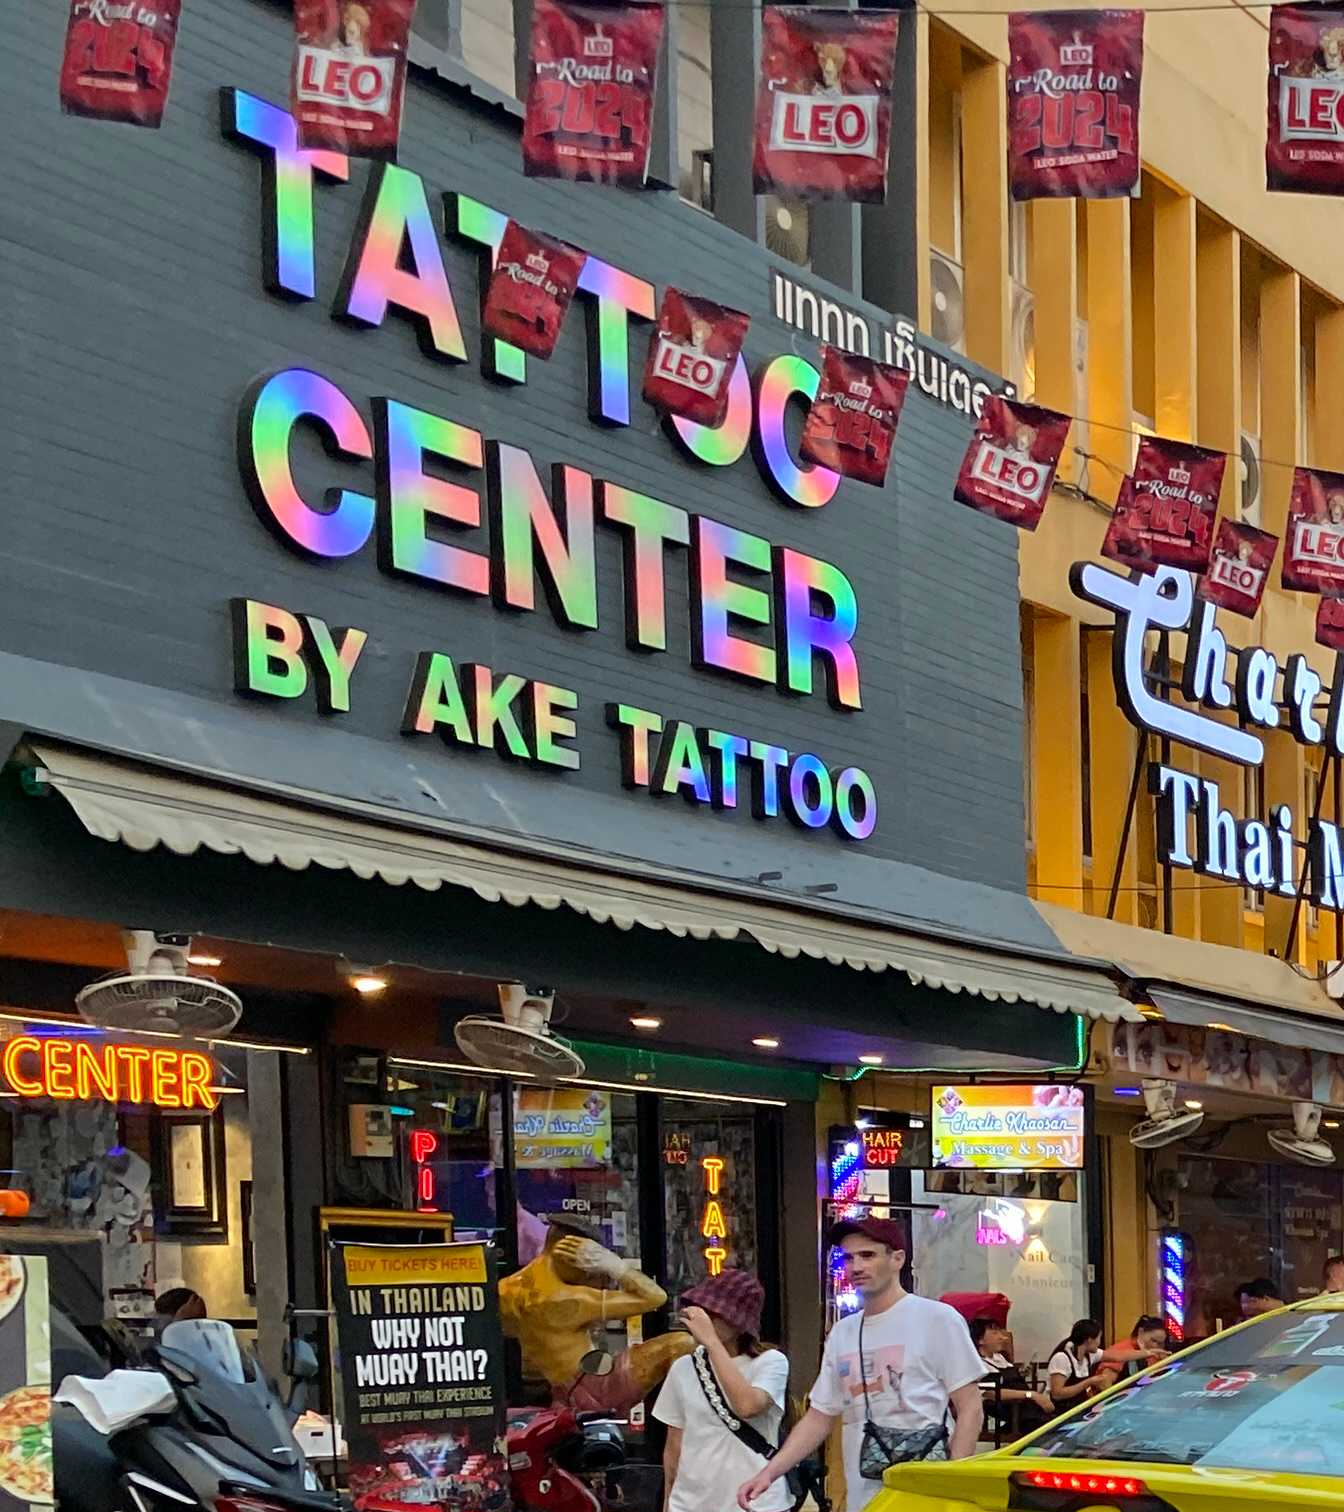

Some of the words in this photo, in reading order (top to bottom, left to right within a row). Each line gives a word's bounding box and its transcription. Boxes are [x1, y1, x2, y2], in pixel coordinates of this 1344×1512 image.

[300, 56, 383, 103] LEO
[560, 57, 612, 85] Road
[615, 66, 633, 82] to
[1033, 69, 1093, 96] Road
[1098, 72, 1118, 92] to
[782, 104, 865, 146] LEO
[1017, 92, 1134, 153] 2024
[659, 350, 714, 383] LEO
[982, 451, 1040, 494] LEO
[1149, 480, 1186, 499] Road
[1189, 491, 1202, 503] to
[240, 366, 862, 712] CENTER
[1217, 563, 1255, 588] LEO
[233, 597, 368, 714] BY
[403, 650, 581, 771] AKE
[606, 702, 878, 842] TATTOO
[1155, 764, 1298, 897] Thai
[4, 1036, 218, 1111] CENTER
[939, 1112, 1002, 1135] Charlie
[1006, 1112, 1078, 1135] Khaosan
[863, 1130, 903, 1150] HAIR
[952, 1141, 1011, 1158] Massage
[1018, 1141, 1031, 1156] &
[1036, 1141, 1064, 1159] Spa
[866, 1148, 899, 1167] CUT
[562, 1198, 591, 1212] OPEN
[349, 1259, 377, 1273] BUY
[382, 1257, 438, 1273] TICKETS
[350, 1289, 372, 1315] IN
[380, 1286, 485, 1314] THAILAND
[371, 1318, 421, 1350] WHY
[425, 1316, 465, 1347] NOT
[355, 1352, 418, 1387] MUAY
[422, 1349, 488, 1383] THAI?
[359, 1393, 381, 1408] BEST
[437, 1385, 493, 1403] EXPERIENCE
